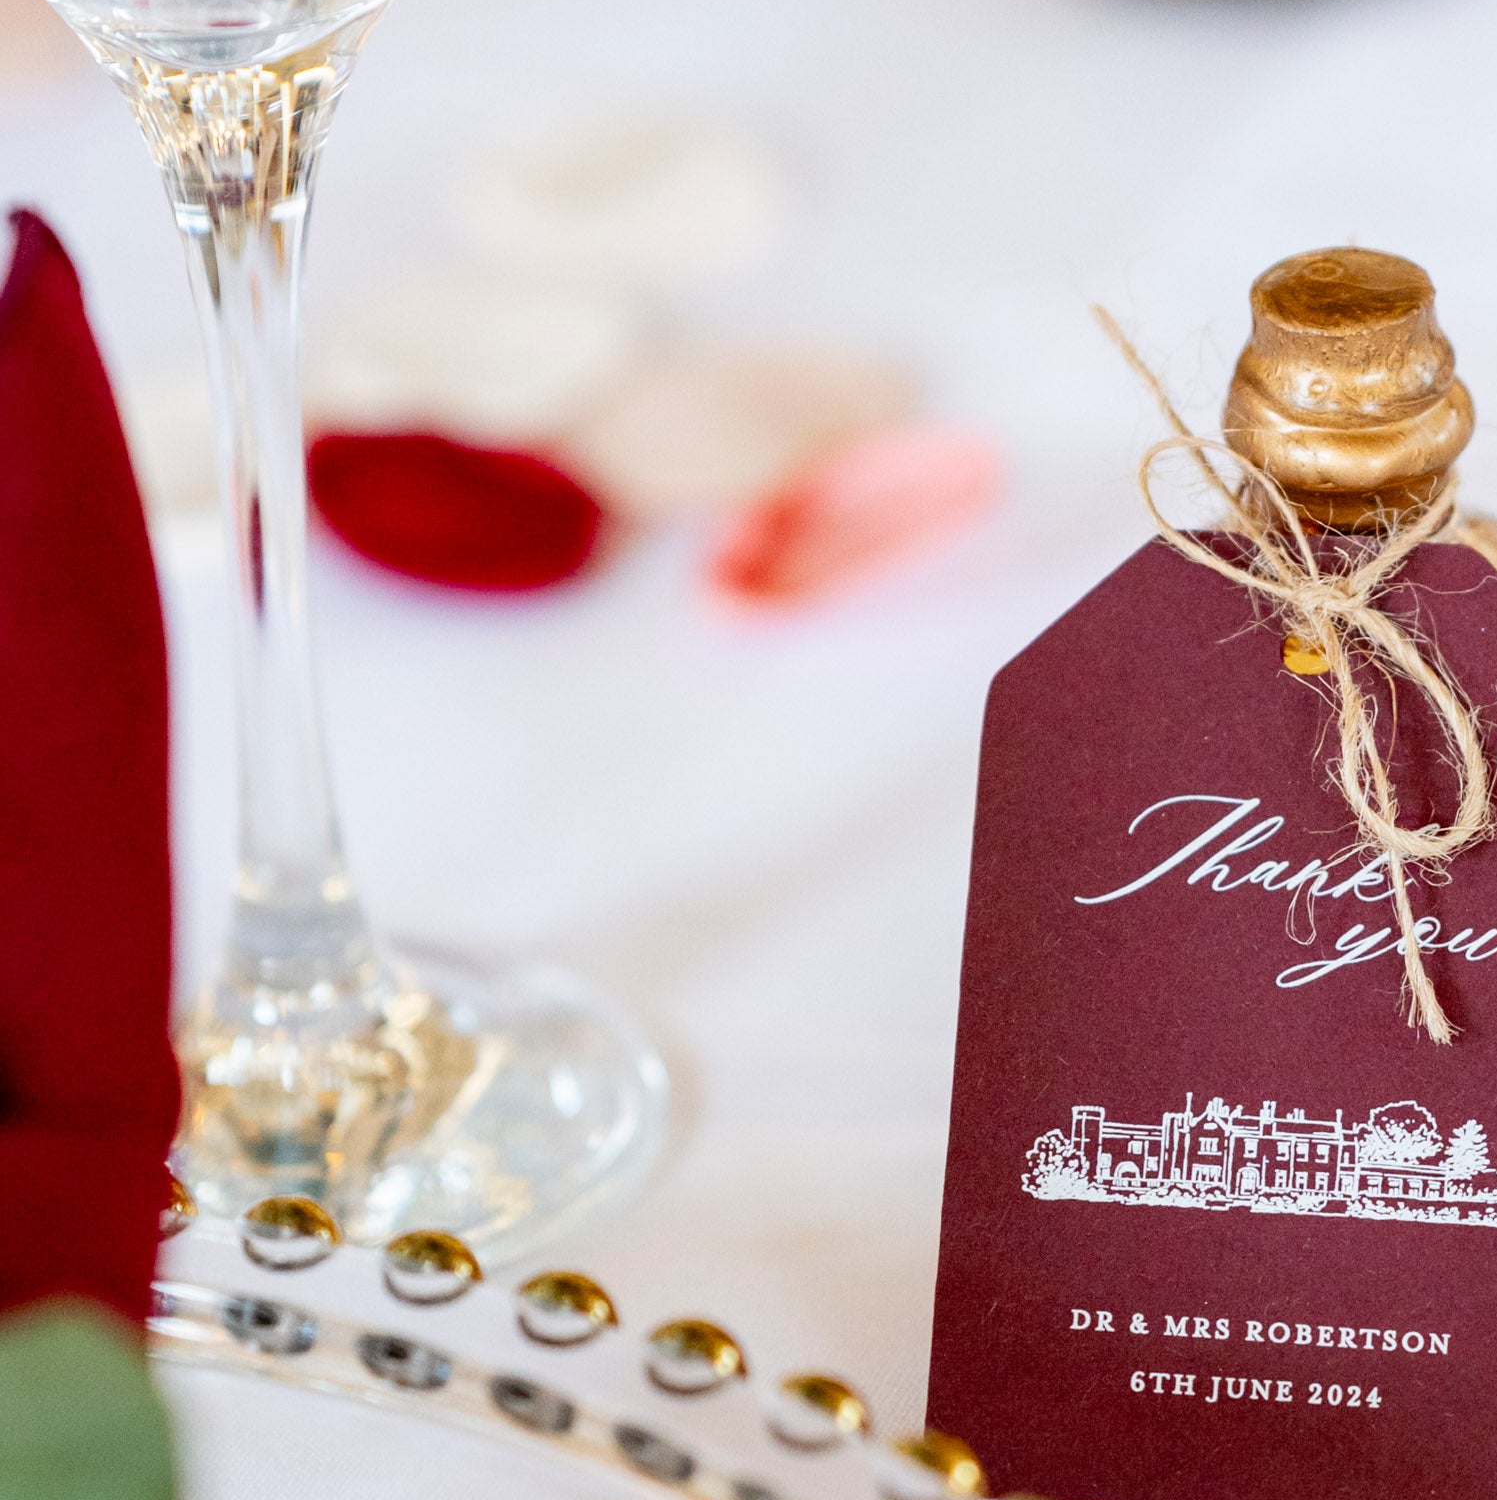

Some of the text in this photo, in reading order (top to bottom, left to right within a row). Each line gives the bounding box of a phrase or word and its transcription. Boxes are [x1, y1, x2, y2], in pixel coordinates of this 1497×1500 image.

[1073, 794, 1441, 905] Thank
[1069, 1308, 1452, 1356] DR & MRS ROBERTSON
[1129, 1370, 1383, 1409] 6TH JUNE 2024
